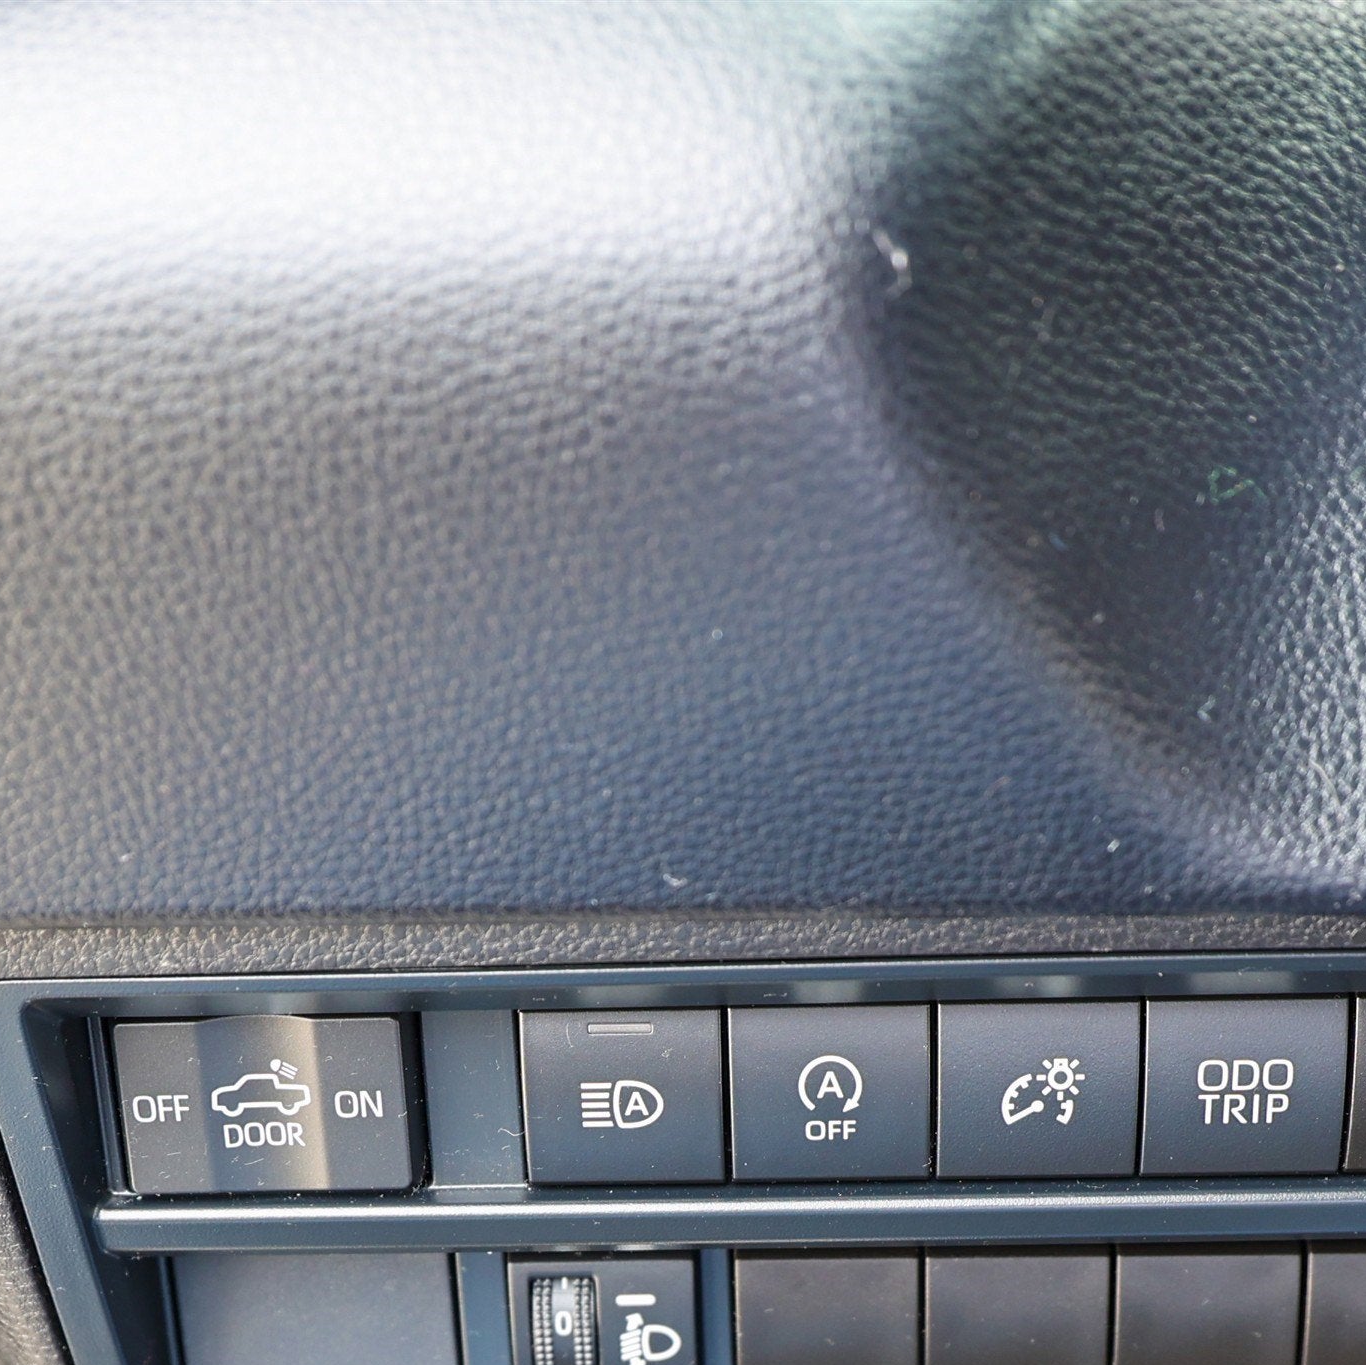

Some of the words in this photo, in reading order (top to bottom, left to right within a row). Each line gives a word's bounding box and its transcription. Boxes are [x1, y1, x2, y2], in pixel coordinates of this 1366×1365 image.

[816, 1070, 844, 1099] A
[1197, 1058, 1294, 1091] ODO
[132, 1094, 190, 1123] OFF
[334, 1090, 384, 1119] ON
[624, 1091, 649, 1117] A
[1197, 1093, 1289, 1125] TRIP
[223, 1121, 306, 1149] DOOR
[805, 1119, 857, 1141] OFF
[554, 1310, 573, 1337] 0
